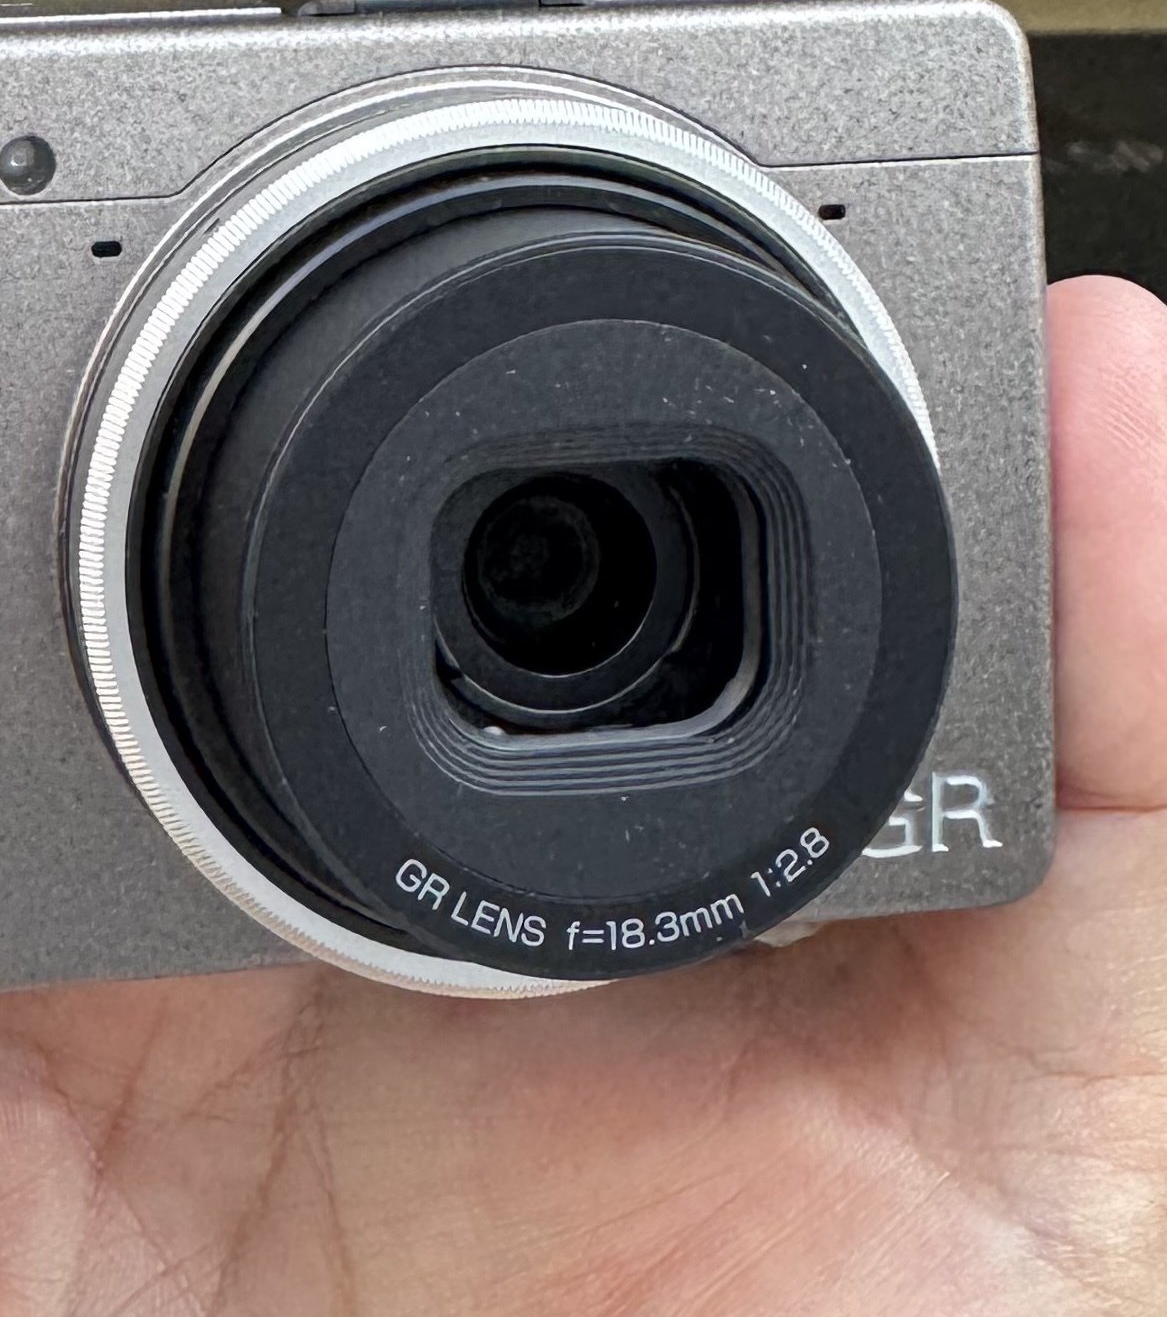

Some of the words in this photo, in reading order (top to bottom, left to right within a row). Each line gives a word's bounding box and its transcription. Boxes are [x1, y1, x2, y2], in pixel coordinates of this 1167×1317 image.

[395, 858, 450, 911] GR
[450, 891, 547, 947] LENS
[566, 893, 744, 951] f=18.3mm
[750, 826, 830, 897] 1:2.8
